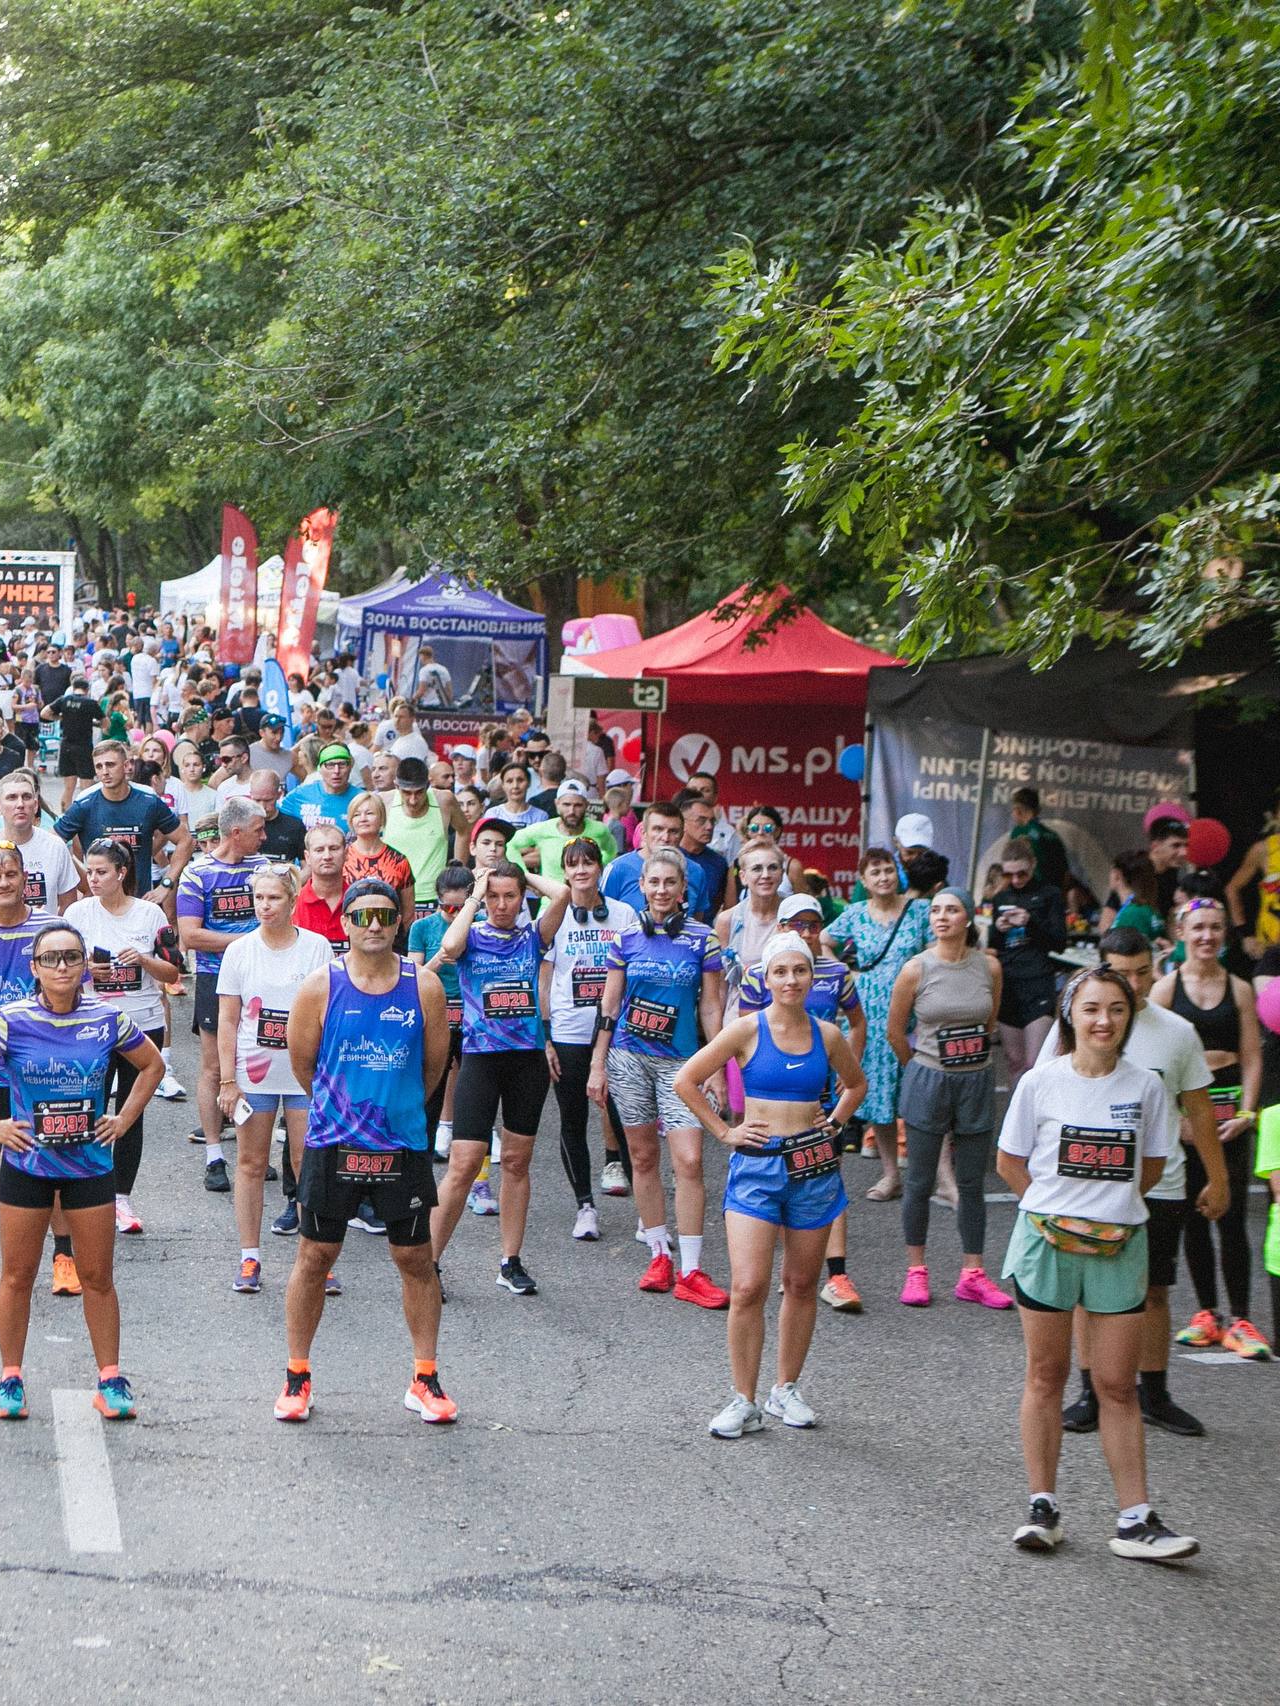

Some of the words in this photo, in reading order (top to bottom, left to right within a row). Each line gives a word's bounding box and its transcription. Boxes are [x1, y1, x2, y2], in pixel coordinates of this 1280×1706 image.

[17, 571, 55, 582] БЕГА
[365, 612, 407, 628] ЗОНА
[409, 615, 546, 635] ВОССТАНОВЛЕНИЯ
[633, 681, 661, 708] t2
[42, 1114, 89, 1135] 9292
[345, 1154, 394, 1173] 9287
[1067, 1143, 1126, 1166] 9240
